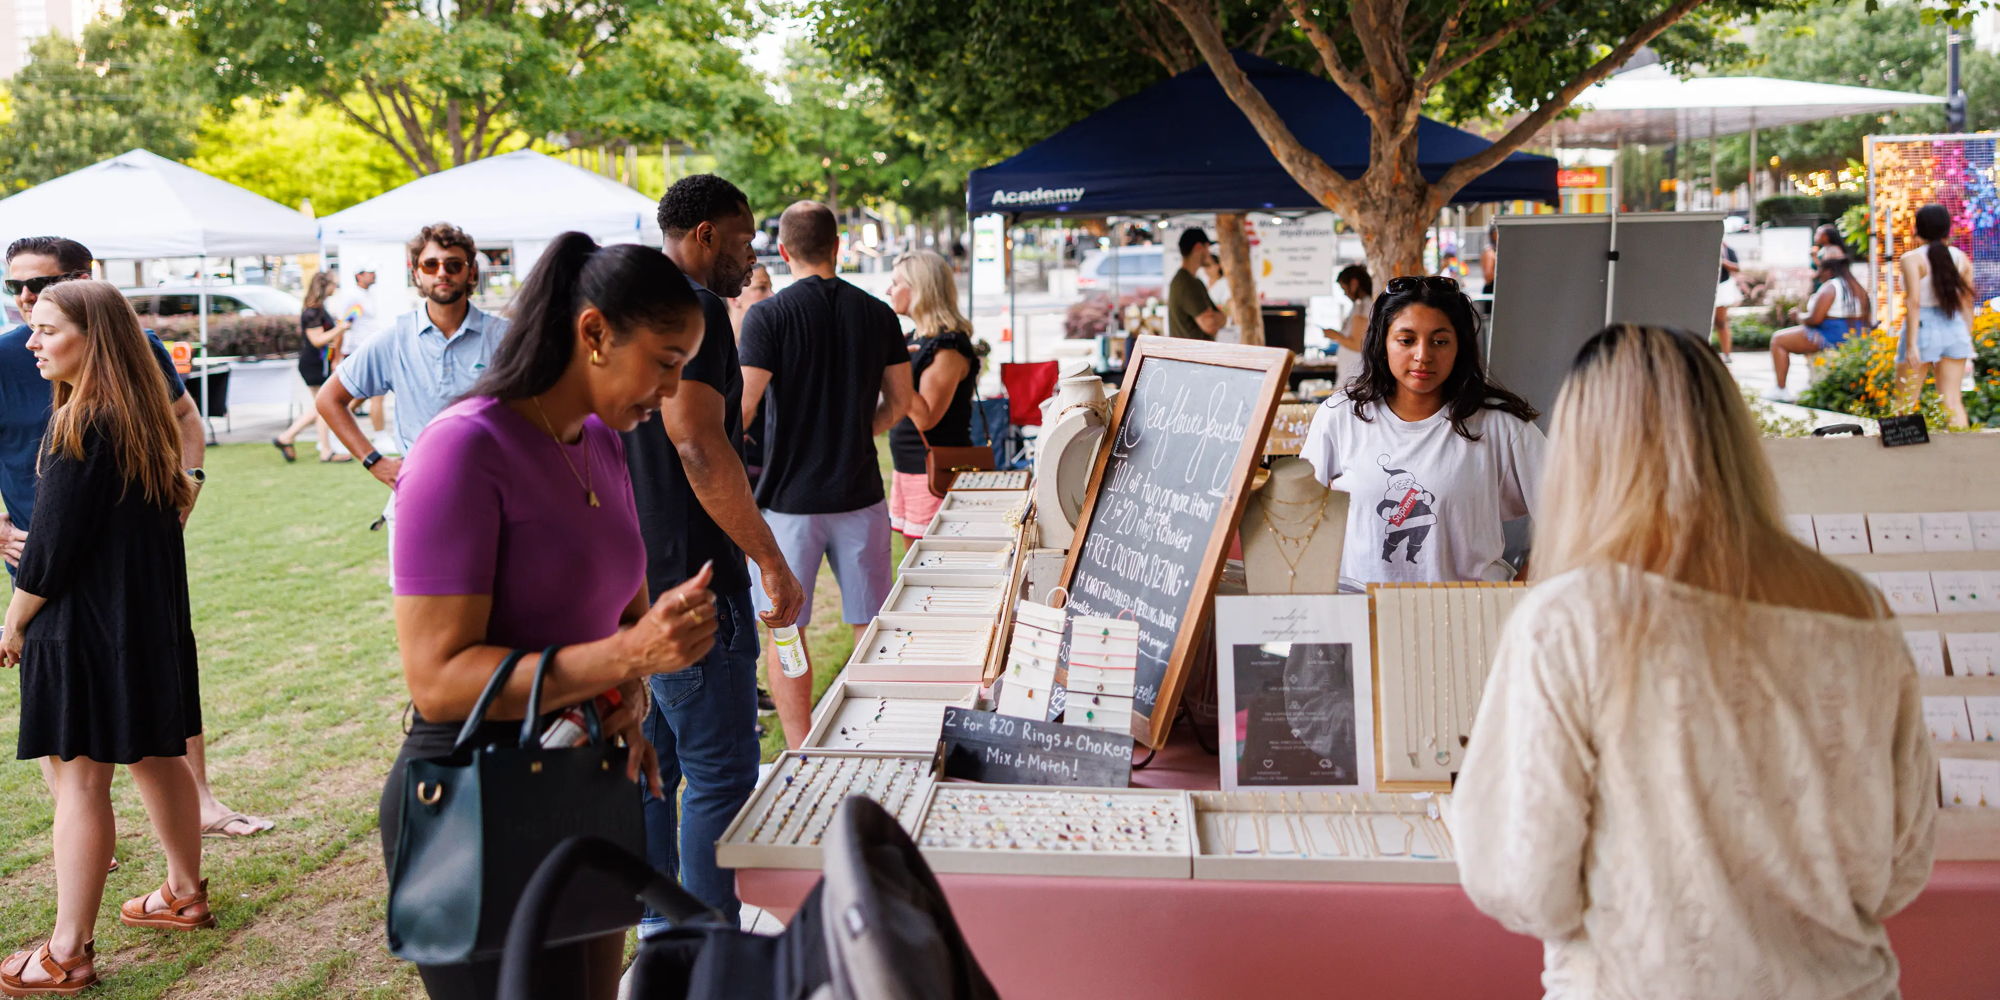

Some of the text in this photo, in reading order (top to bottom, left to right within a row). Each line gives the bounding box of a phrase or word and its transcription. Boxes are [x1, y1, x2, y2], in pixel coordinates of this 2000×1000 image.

[991, 187, 1085, 205] Academy
[1108, 459, 1214, 522] 10% off two or more items
[1100, 494, 1114, 525] 2
[1392, 492, 1416, 523] Supreme
[1087, 533, 1185, 597] FREE CUSTOM SIZING
[945, 711, 956, 727] 2
[963, 716, 983, 732] for
[989, 717, 1014, 736] $20
[1022, 722, 1061, 751] Rings
[986, 748, 1011, 765] Mix
